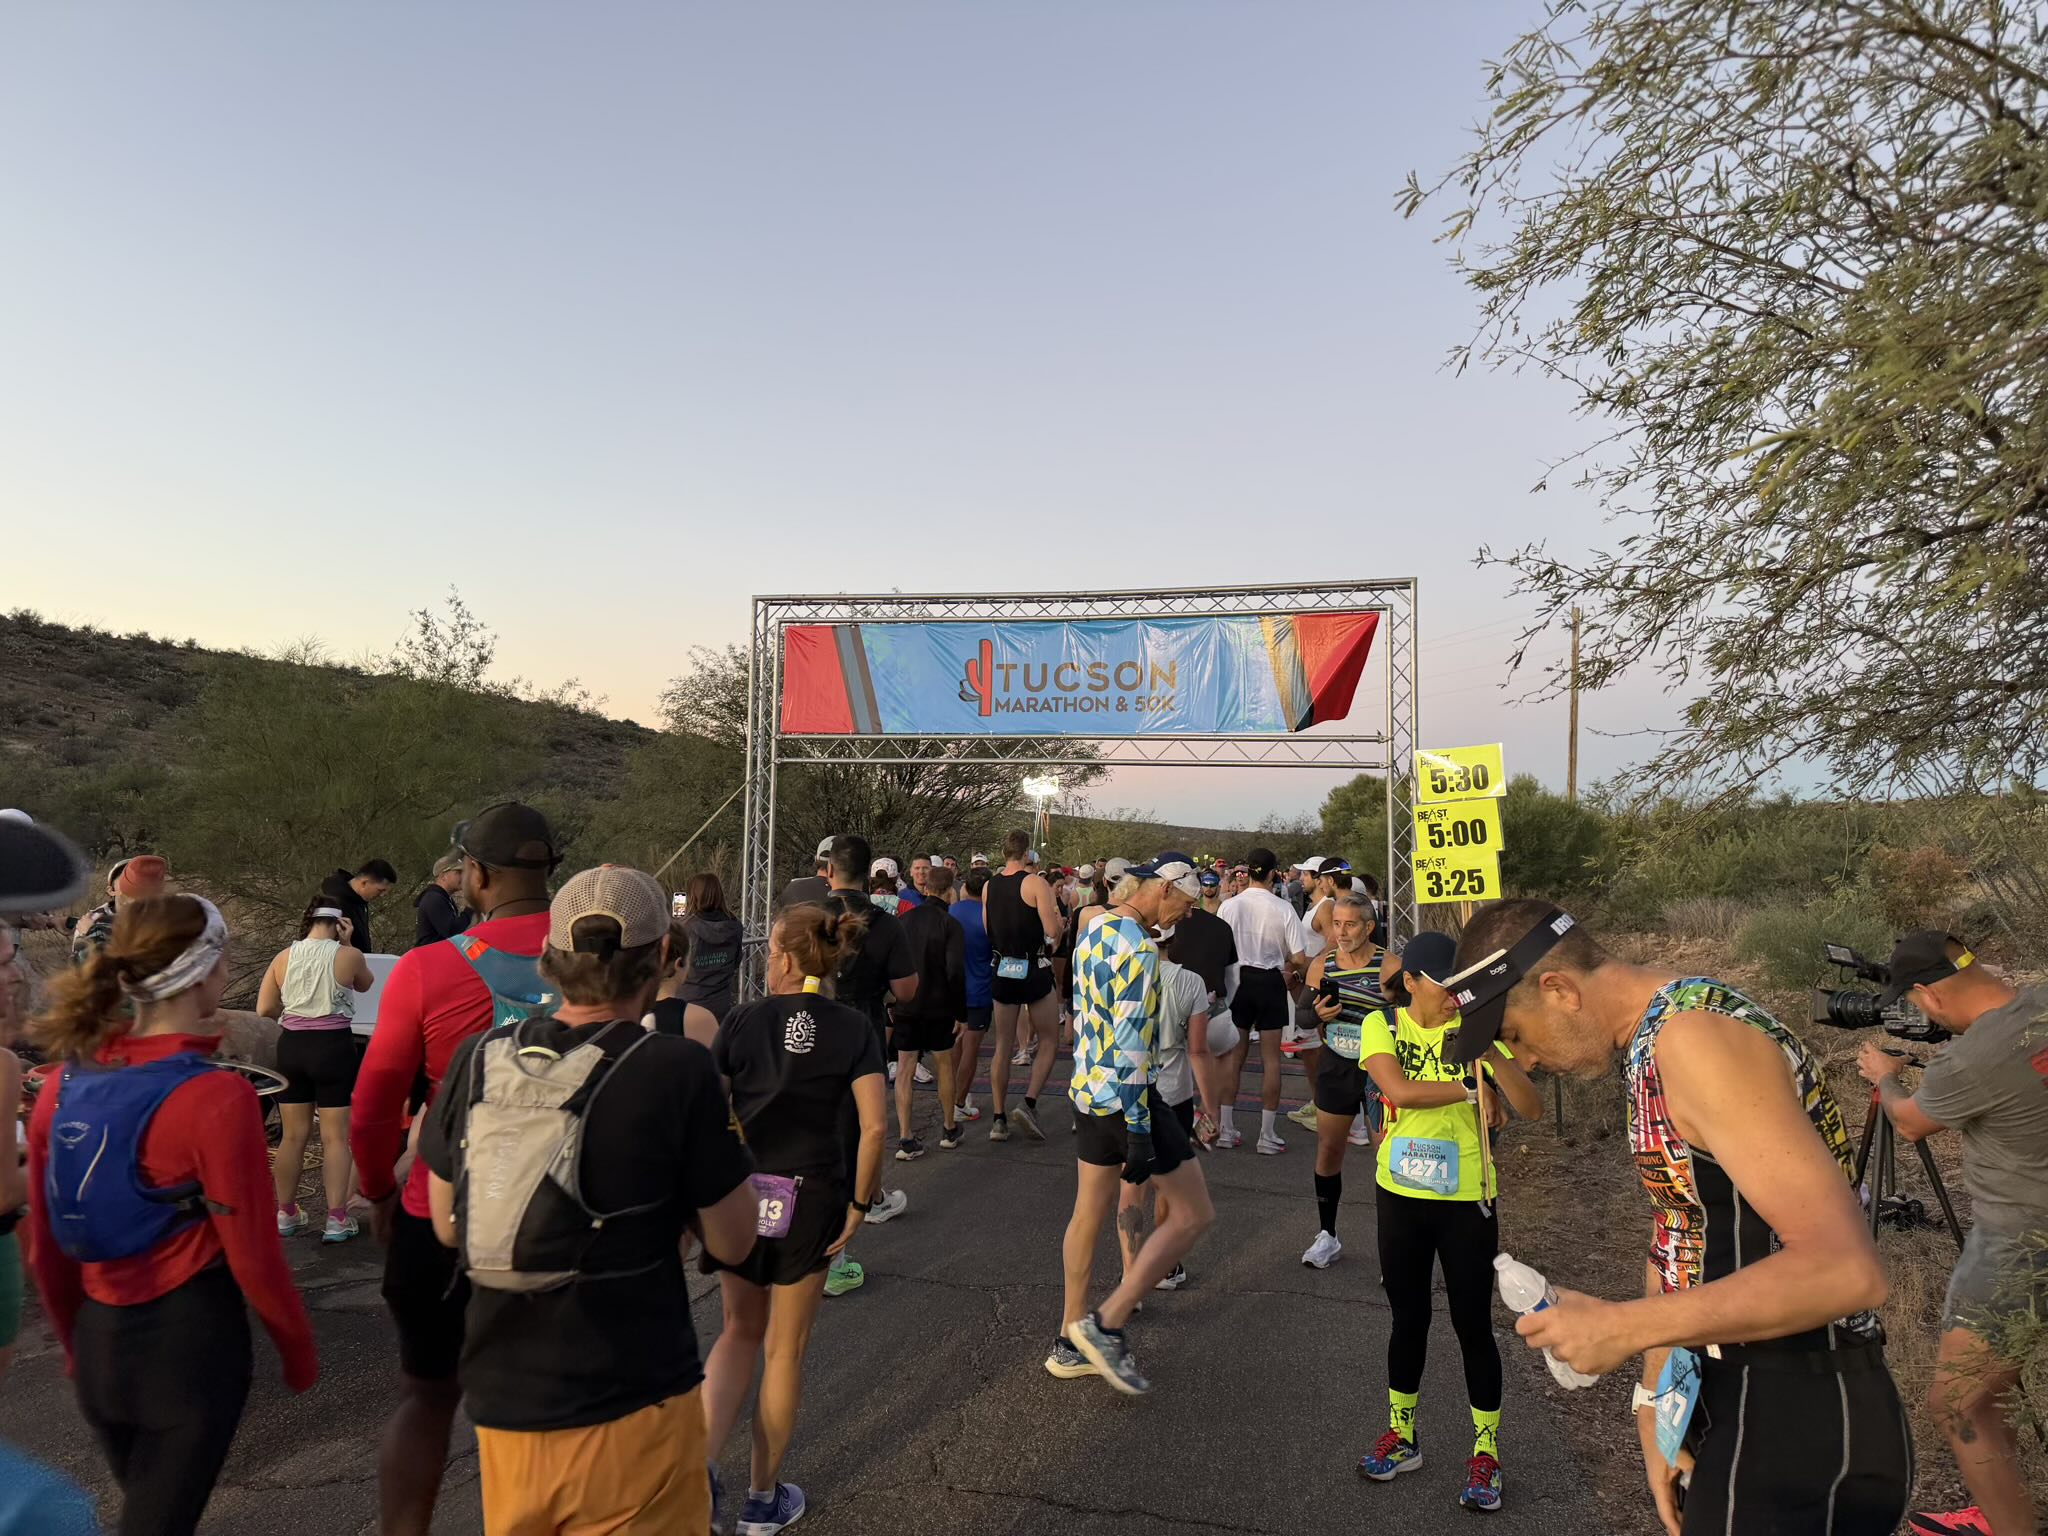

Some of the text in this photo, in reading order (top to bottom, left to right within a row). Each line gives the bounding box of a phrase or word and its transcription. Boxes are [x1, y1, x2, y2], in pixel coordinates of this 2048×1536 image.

[996, 661, 1177, 692] TUCSON
[995, 696, 1175, 713] MARATHON & 50K
[1430, 764, 1489, 794] 5:30
[1417, 809, 1448, 822] BEAST
[1428, 818, 1488, 849] 5:00
[1415, 857, 1446, 870] BEAST
[1426, 868, 1485, 898] 3:25
[1401, 1151, 1446, 1160] MARATHON
[1399, 1157, 1448, 1179] 1271
